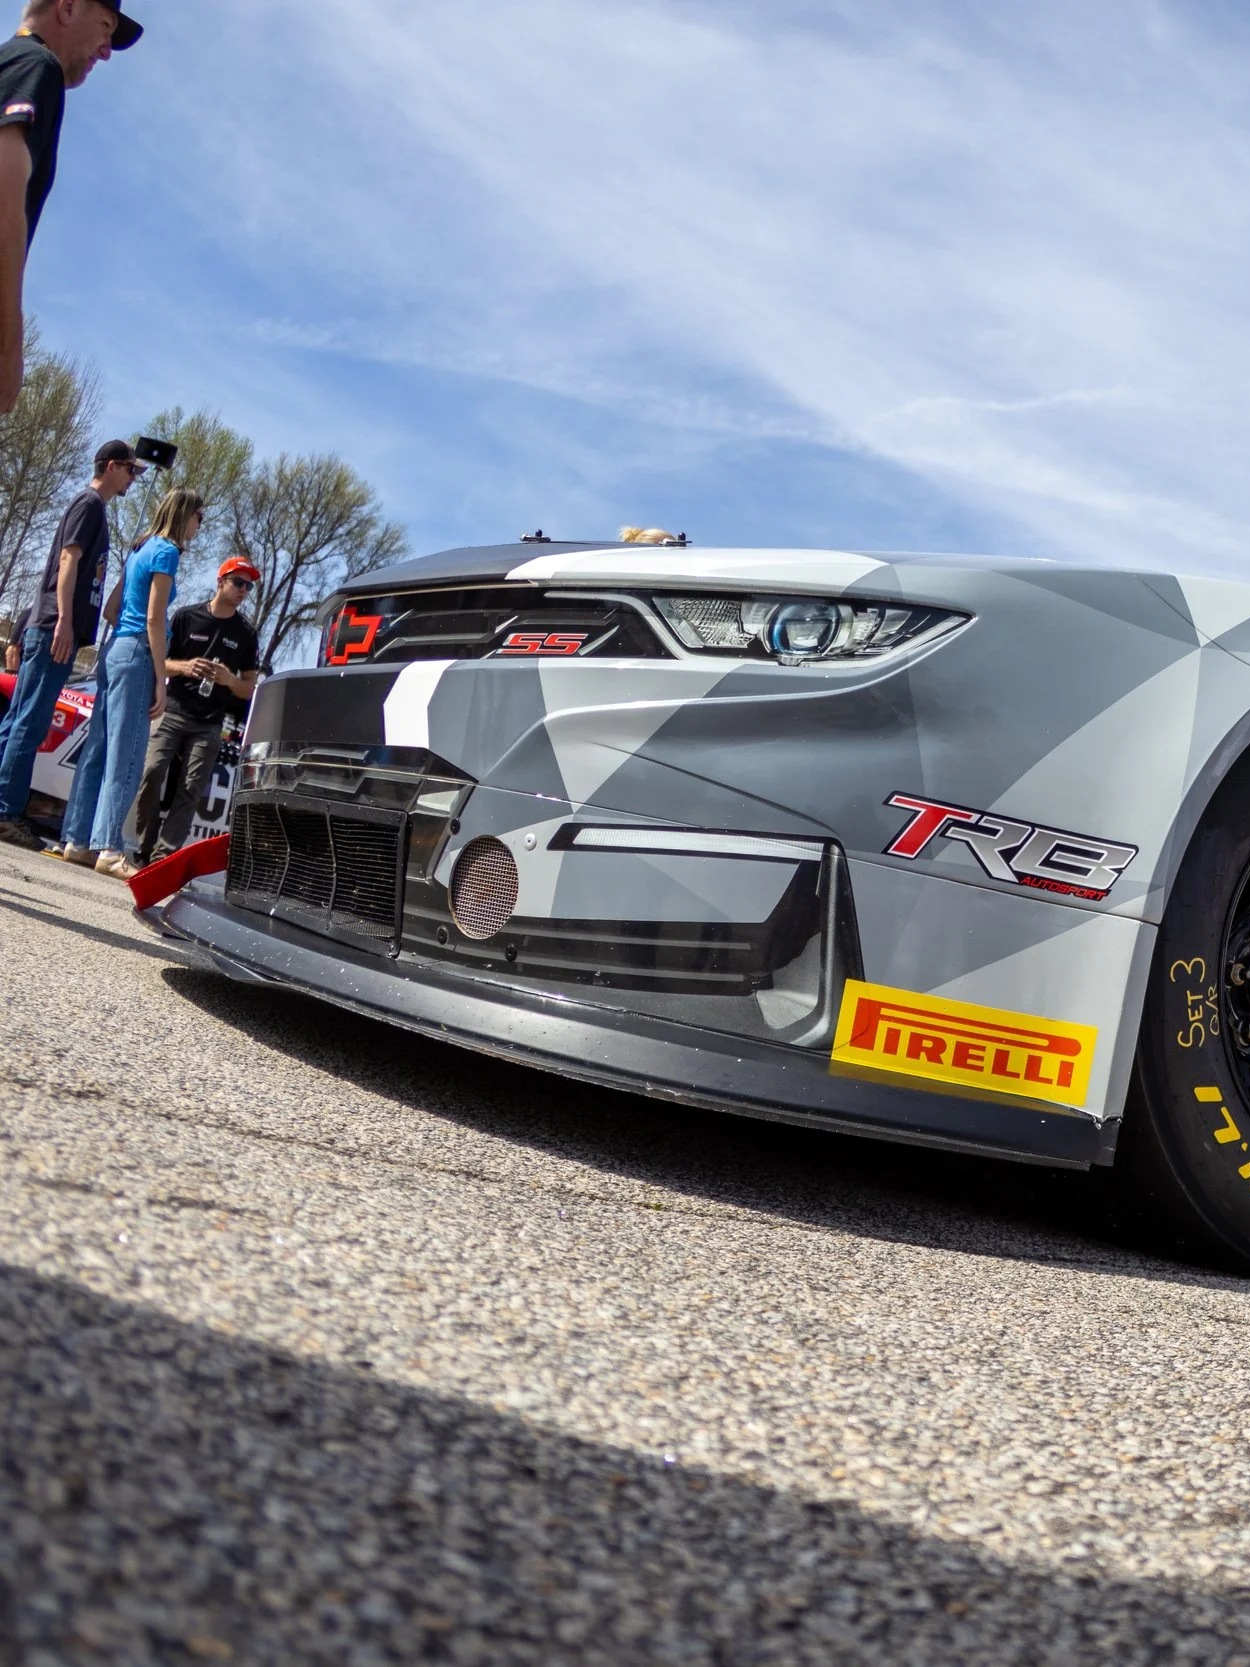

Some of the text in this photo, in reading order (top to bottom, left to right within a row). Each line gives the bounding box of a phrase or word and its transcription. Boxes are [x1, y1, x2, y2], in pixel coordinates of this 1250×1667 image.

[502, 632, 589, 655] SS
[884, 793, 1138, 890] TRB
[1020, 876, 1108, 901] AUTOSPORT
[849, 997, 1082, 1089] PIRELLI
[1170, 957, 1206, 1047] SET 3
